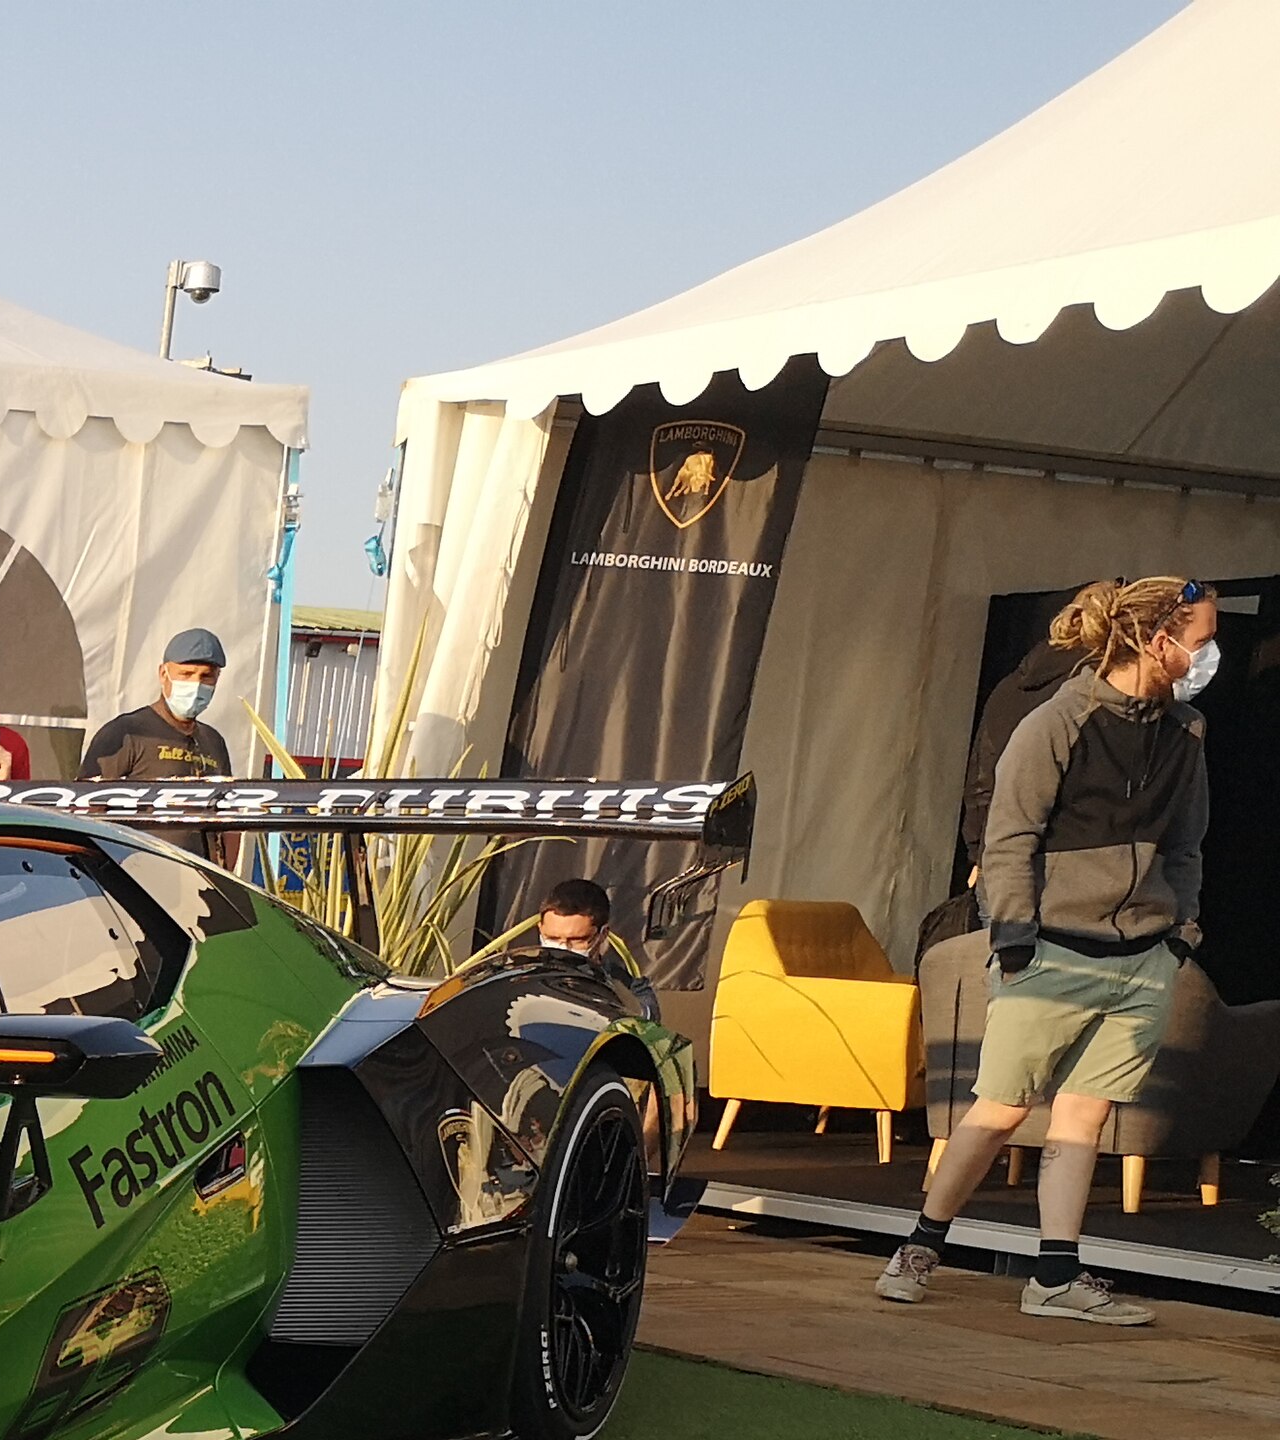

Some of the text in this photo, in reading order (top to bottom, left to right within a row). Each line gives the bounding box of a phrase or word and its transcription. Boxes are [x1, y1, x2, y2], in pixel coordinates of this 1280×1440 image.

[658, 426, 738, 447] LAMBORGHINI
[570, 551, 773, 578] LAMBORGHINI BORDEAUX
[68, 1071, 236, 1230] Fastron
